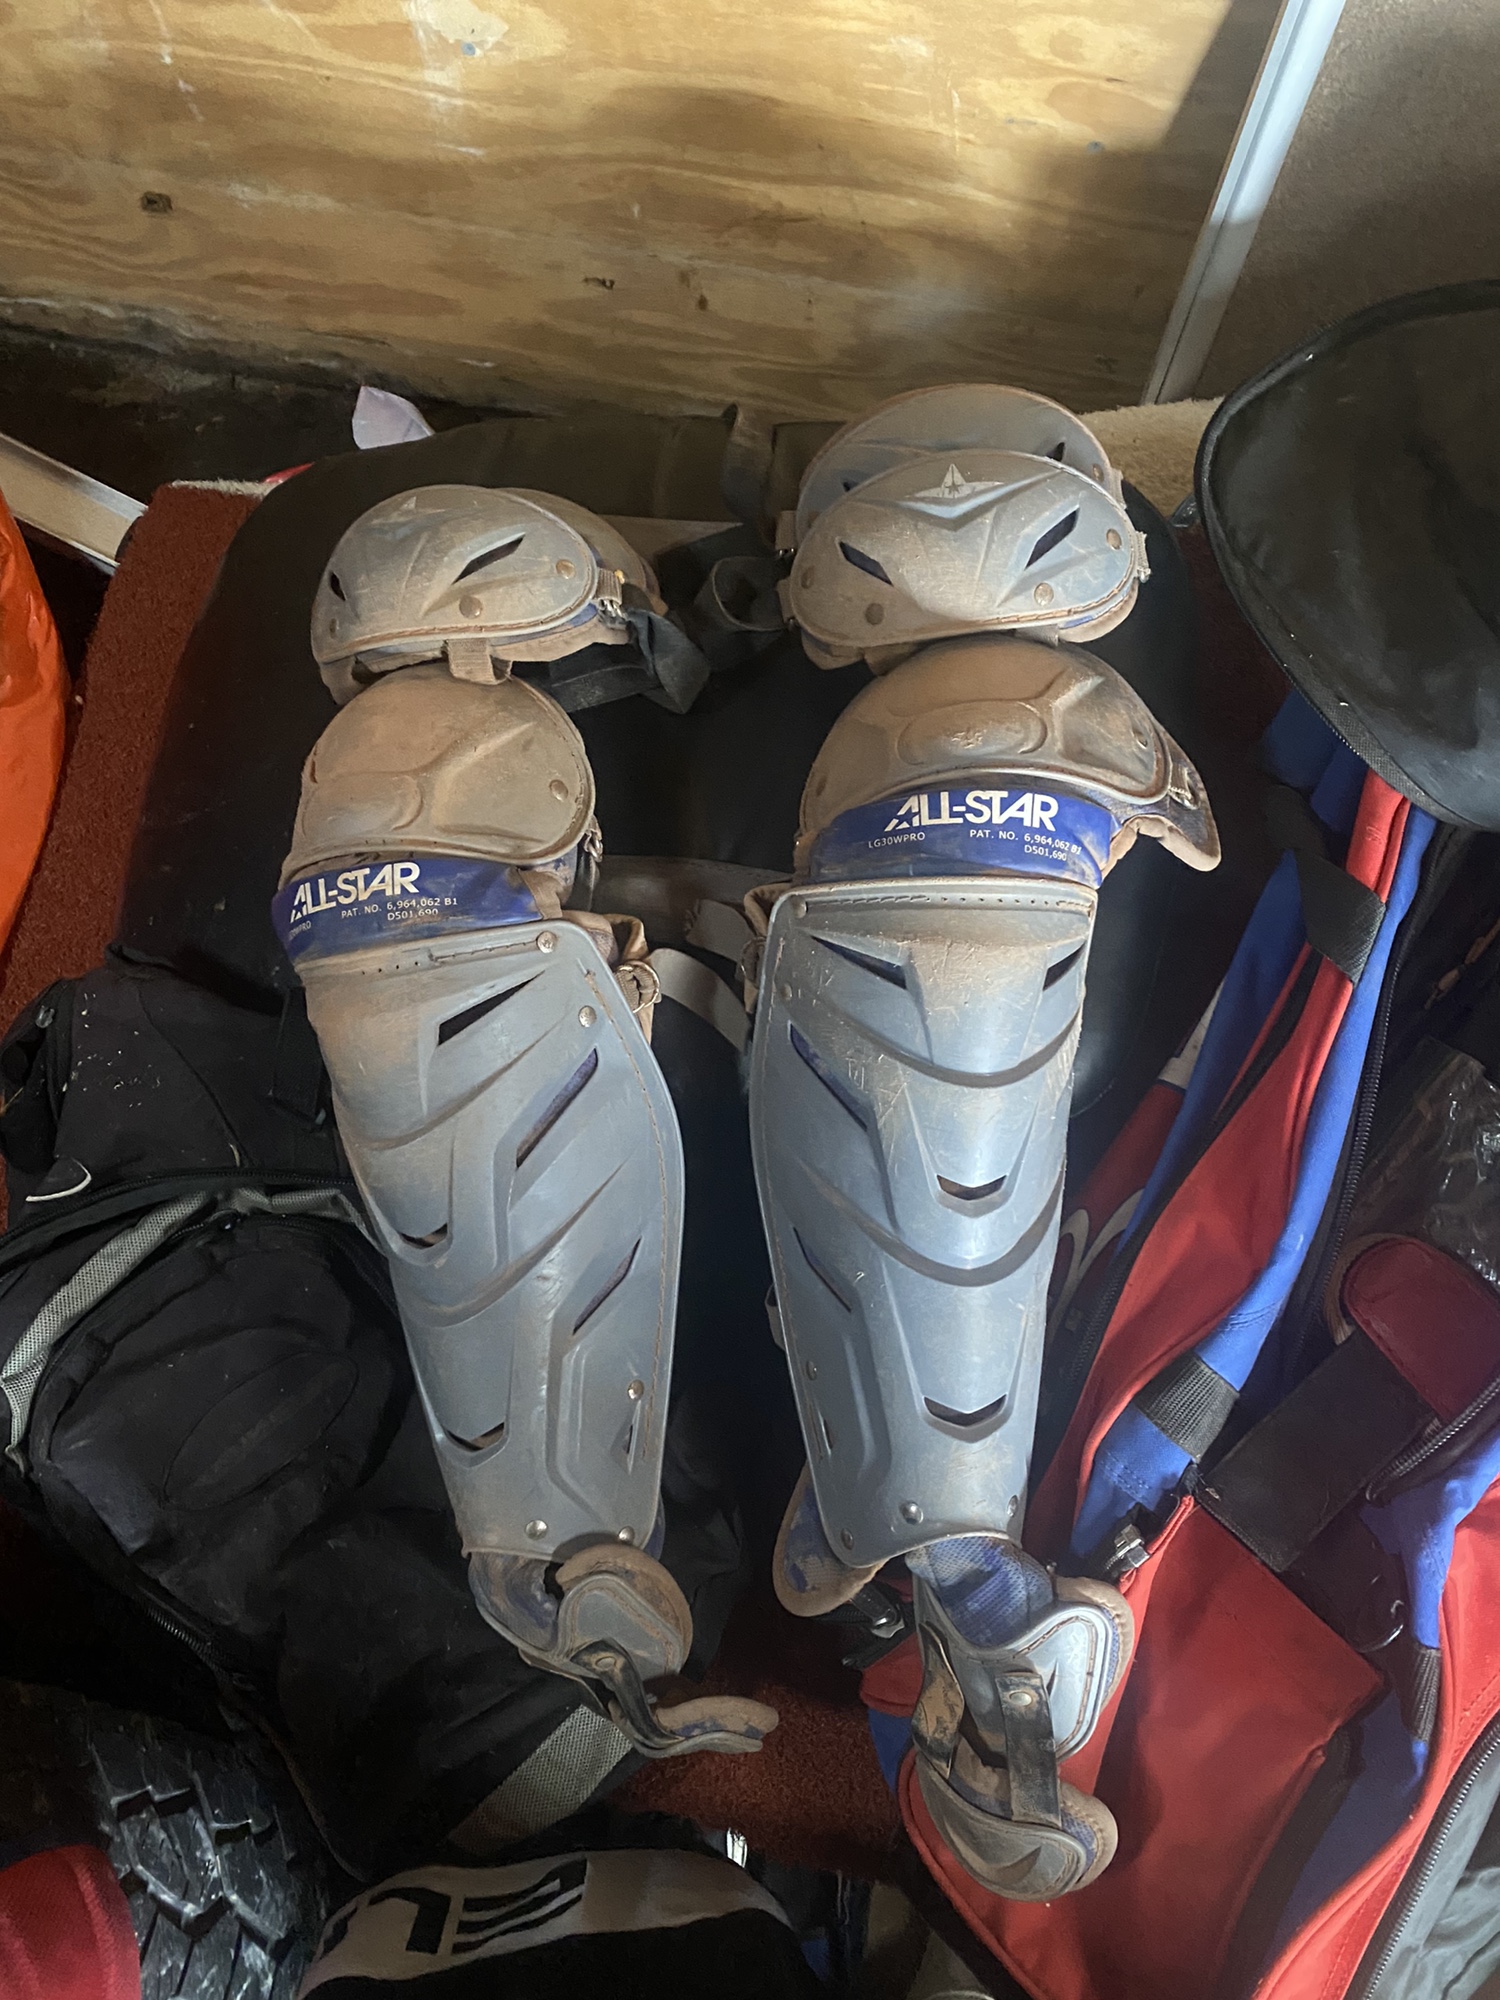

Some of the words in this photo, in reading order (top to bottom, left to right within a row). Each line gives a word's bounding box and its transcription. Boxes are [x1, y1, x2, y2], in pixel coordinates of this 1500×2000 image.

[884, 790, 1059, 832] ALL-STAR
[868, 832, 926, 849] LG30WPRO
[969, 829, 995, 839] PAT.
[998, 830, 1019, 841] NO.
[1023, 832, 1070, 851] 6,964,062
[1070, 844, 1082, 855] B1
[1024, 844, 1067, 861] D501,690
[290, 861, 421, 923] ALL-STAR
[341, 908, 361, 919] PAT.
[364, 904, 382, 914] NO.
[386, 897, 440, 911] 6,964,062
[444, 897, 458, 906] B1
